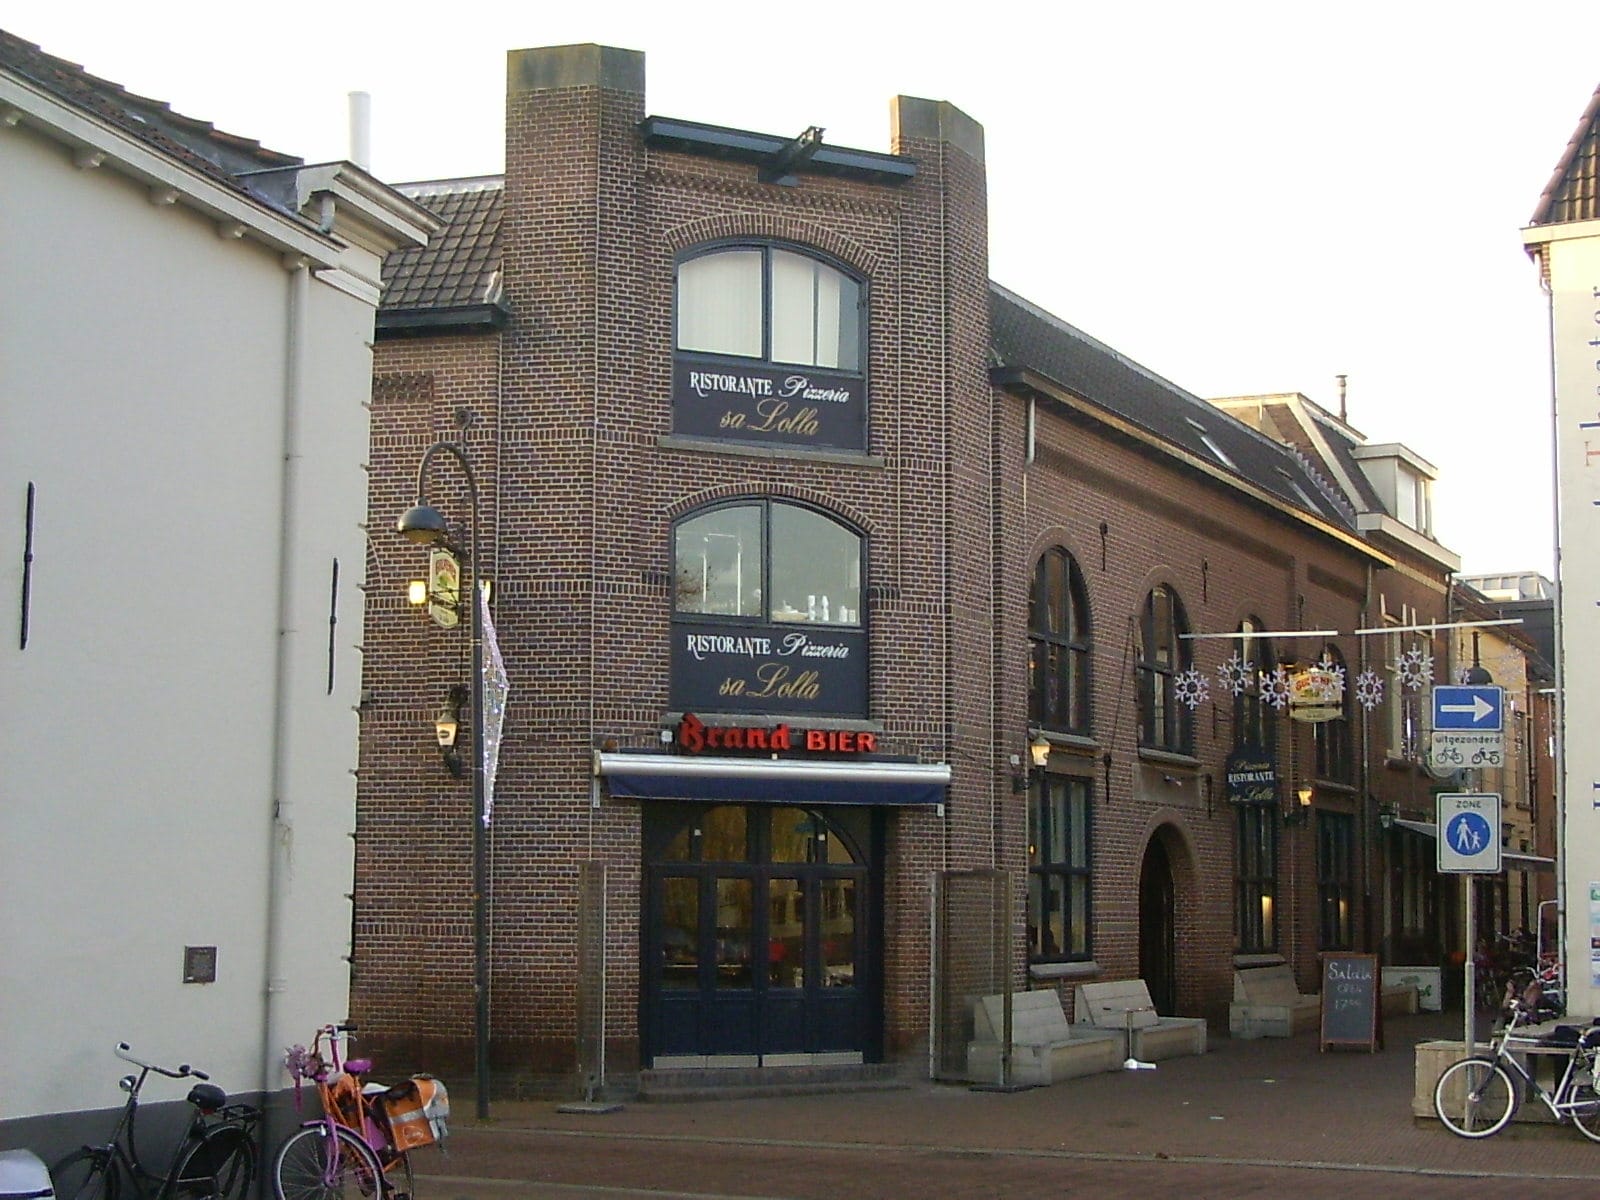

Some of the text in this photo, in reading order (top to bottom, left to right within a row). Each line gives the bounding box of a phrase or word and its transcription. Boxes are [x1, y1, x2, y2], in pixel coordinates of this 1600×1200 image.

[690, 371, 849, 403] RISTORANTE Pizzeria
[719, 399, 820, 435] sa Lolla
[687, 632, 849, 660] RISTORANTE Pizzeria
[719, 663, 821, 699] sa Lolla
[679, 712, 878, 752] Brand BIER
[1435, 735, 1501, 746] uitgezonderd
[1455, 800, 1482, 809] ZONE
